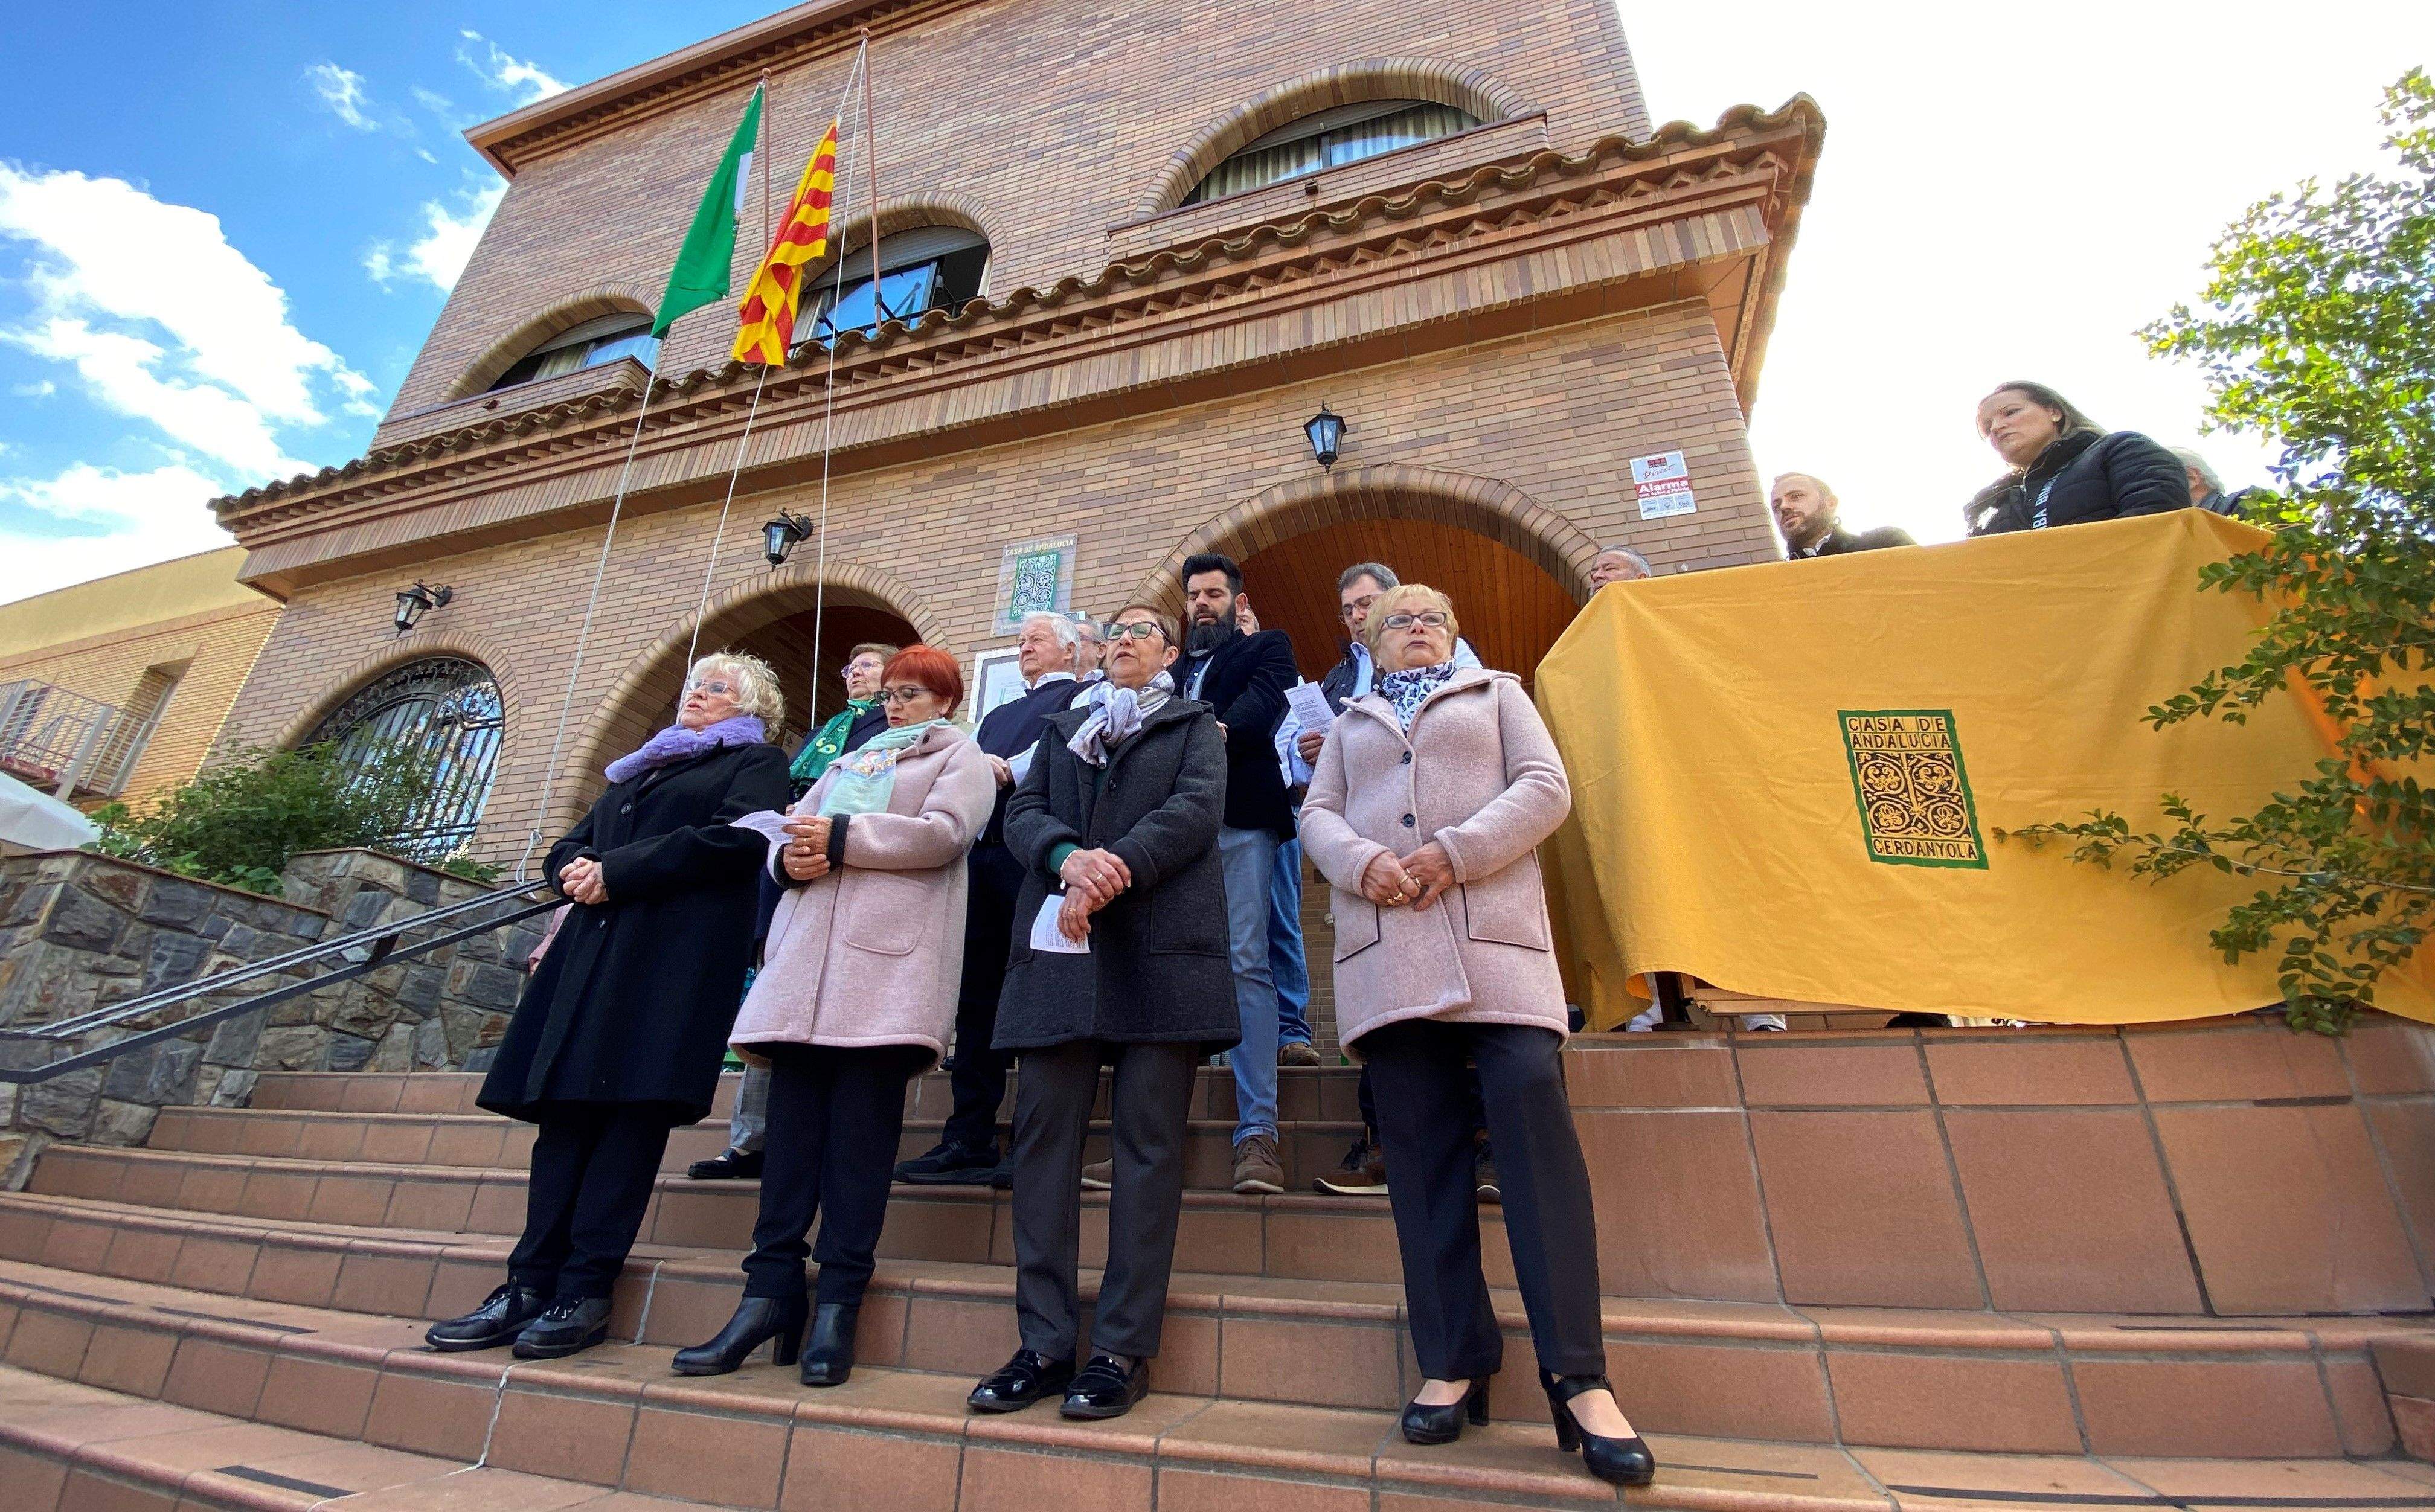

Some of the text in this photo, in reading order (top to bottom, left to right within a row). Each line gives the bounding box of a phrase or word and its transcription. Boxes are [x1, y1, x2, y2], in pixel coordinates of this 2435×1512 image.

[1639, 480, 1689, 494] Alarma
[2033, 508, 2048, 529] BA
[1006, 548, 1022, 556] CASA
[1019, 561, 1055, 573] ANDALUCIA
[1020, 557, 1041, 565] CASA
[1848, 717, 1946, 732] CASA DE
[1852, 734, 1951, 748] ANDALUCIA
[1873, 838, 1978, 859] CERDANYOLA
